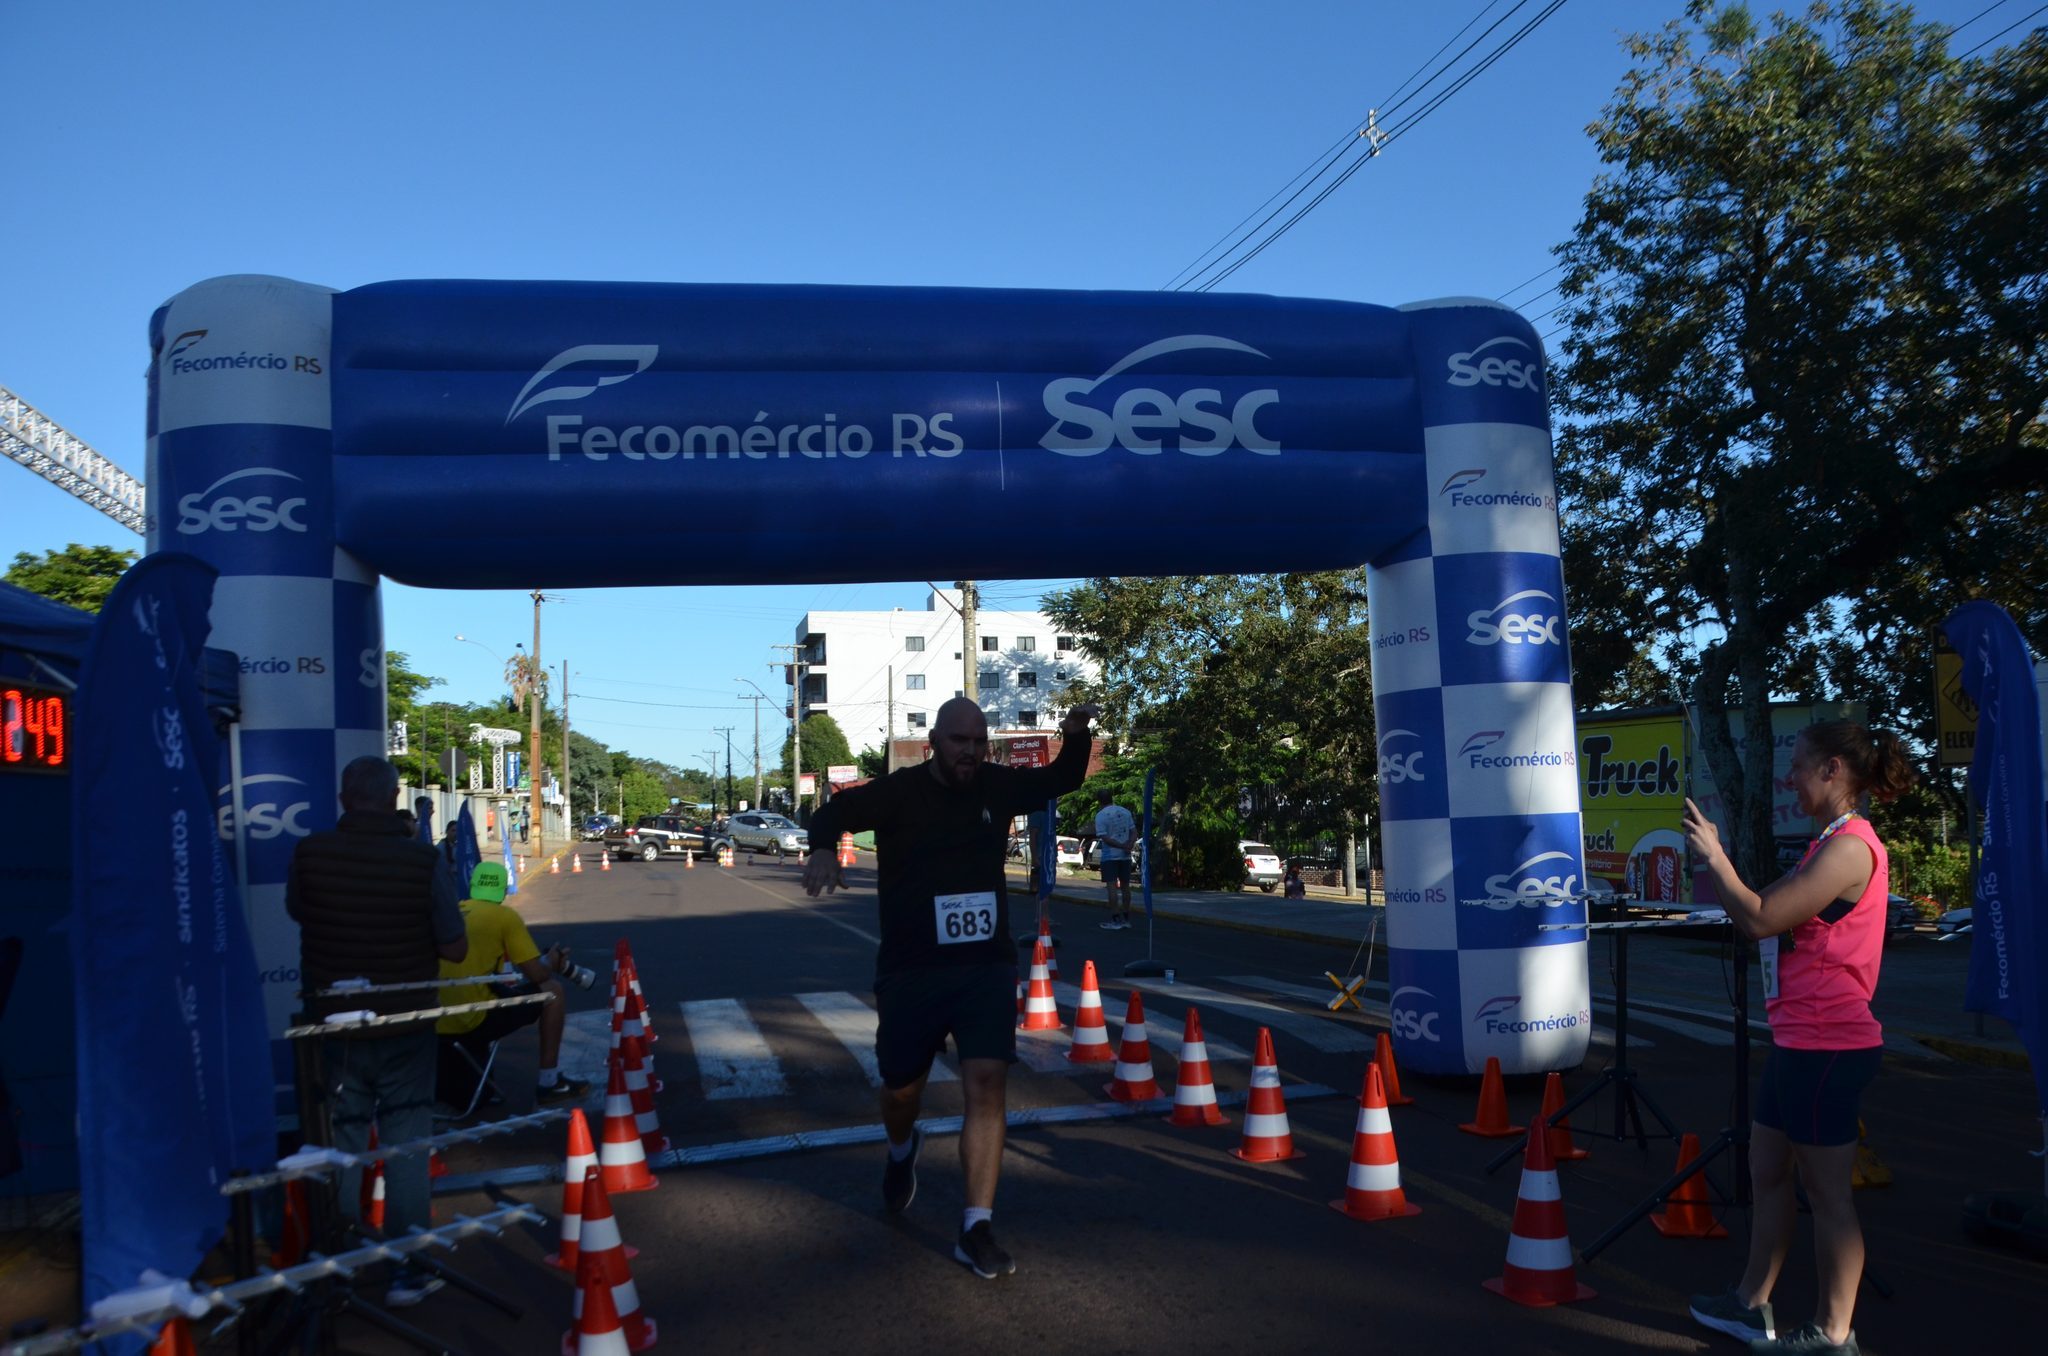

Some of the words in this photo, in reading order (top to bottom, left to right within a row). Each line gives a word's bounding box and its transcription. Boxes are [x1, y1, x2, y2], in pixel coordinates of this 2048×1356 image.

[173, 351, 287, 375] Fecomércio
[294, 355, 322, 375] RS
[1447, 352, 1539, 392] Sesc
[1038, 377, 1281, 457] Sesc
[546, 410, 872, 461] Fecomércio
[891, 412, 964, 458] RS
[176, 493, 307, 535] Sesc
[1451, 490, 1542, 507] Fecomércio
[1544, 495, 1556, 511] RS
[1409, 626, 1430, 643] RS
[1465, 609, 1560, 646] Sesc
[239, 657, 290, 674] ércio
[297, 657, 325, 674] RS
[0, 689, 64, 767] 249
[1945, 731, 1975, 748] ELEV
[1379, 751, 1424, 784] esc
[1470, 751, 1561, 769] Fecomércio
[1564, 752, 1575, 766] RS
[1583, 736, 1679, 797] Truck
[218, 801, 311, 840] esc
[1425, 888, 1446, 903] RS
[1485, 875, 1577, 911] Sesc
[1984, 871, 1999, 896] RS
[946, 909, 991, 938] 683
[1987, 901, 2010, 999] Fecomércio
[1393, 1008, 1440, 1042] esc
[1486, 1014, 1576, 1034] Fecomércio
[1579, 1009, 1590, 1025] RS
